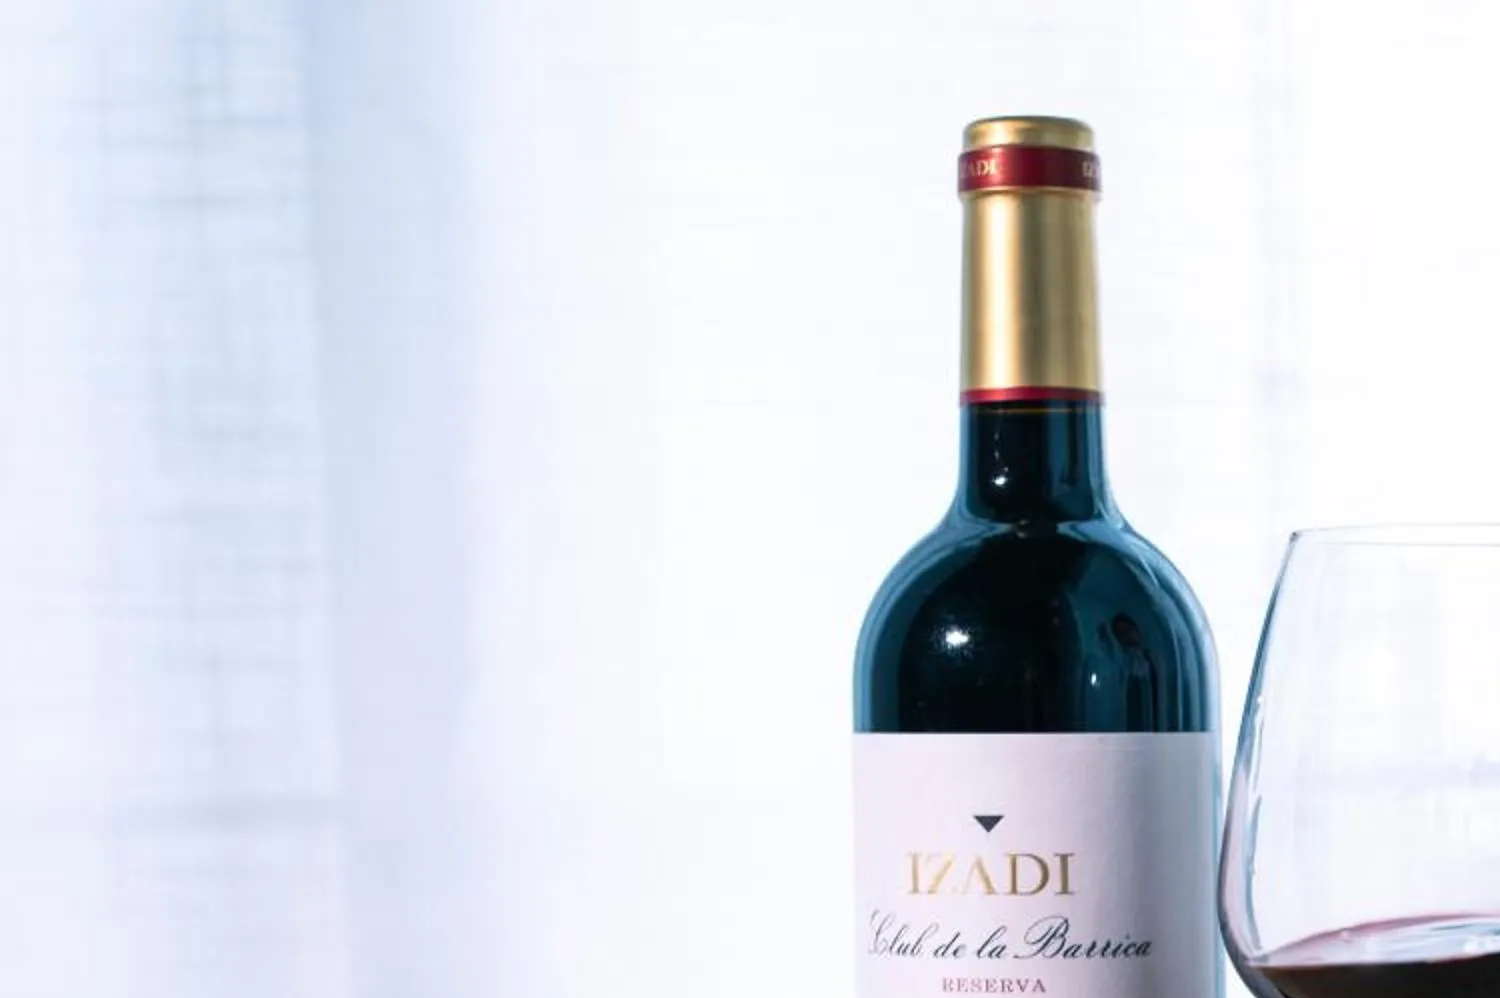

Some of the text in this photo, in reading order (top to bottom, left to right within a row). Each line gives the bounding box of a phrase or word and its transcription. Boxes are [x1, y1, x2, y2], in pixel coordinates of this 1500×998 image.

[907, 852, 1075, 896] IZADI
[868, 908, 1153, 960] Club de la Barrica
[942, 977, 1047, 994] RESERVA
